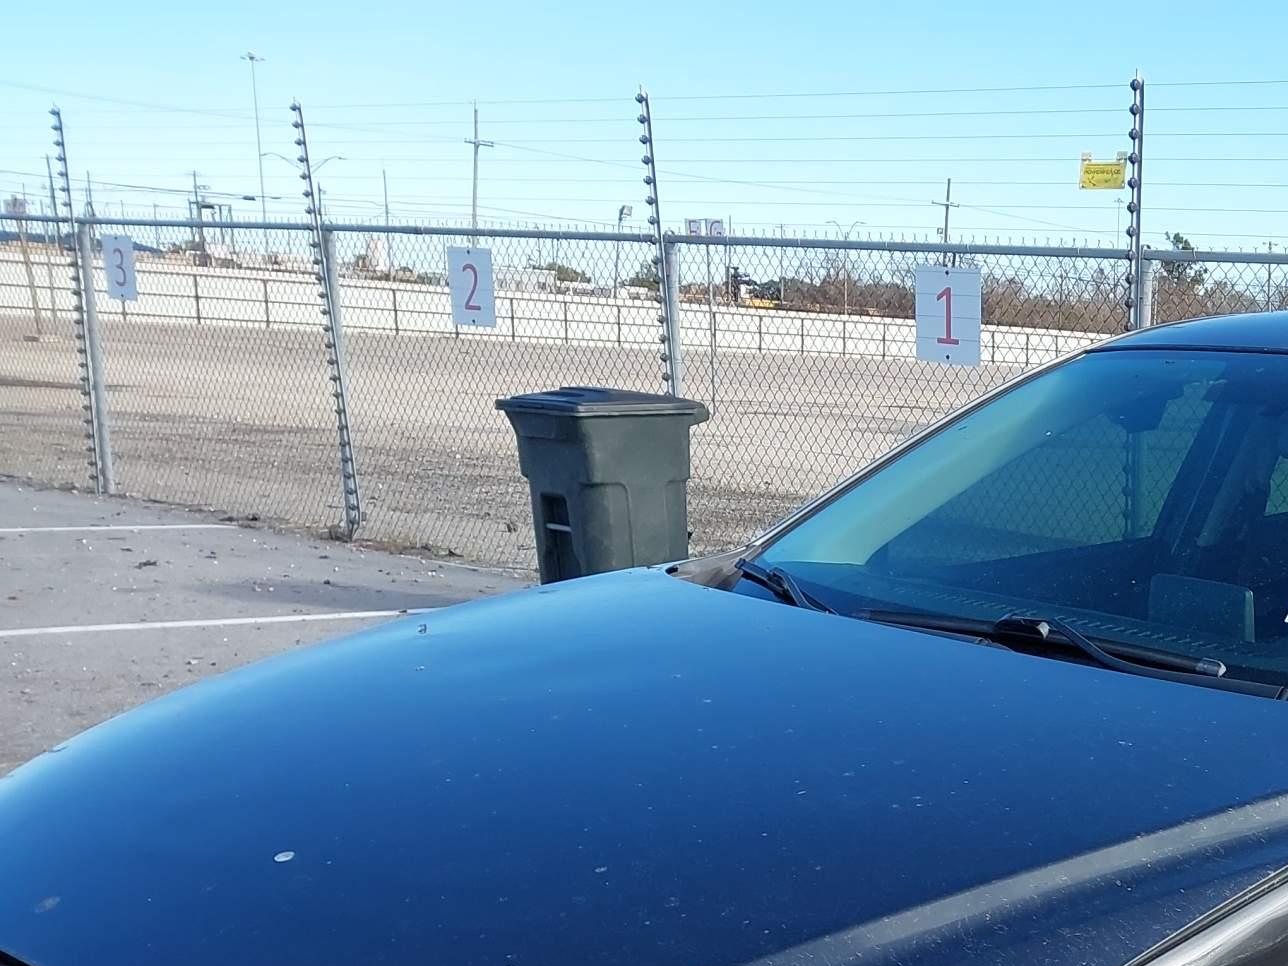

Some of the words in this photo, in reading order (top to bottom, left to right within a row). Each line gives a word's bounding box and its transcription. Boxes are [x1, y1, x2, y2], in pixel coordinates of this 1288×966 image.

[113, 248, 127, 286] 3
[462, 263, 482, 311] 2
[936, 286, 960, 346] 1
